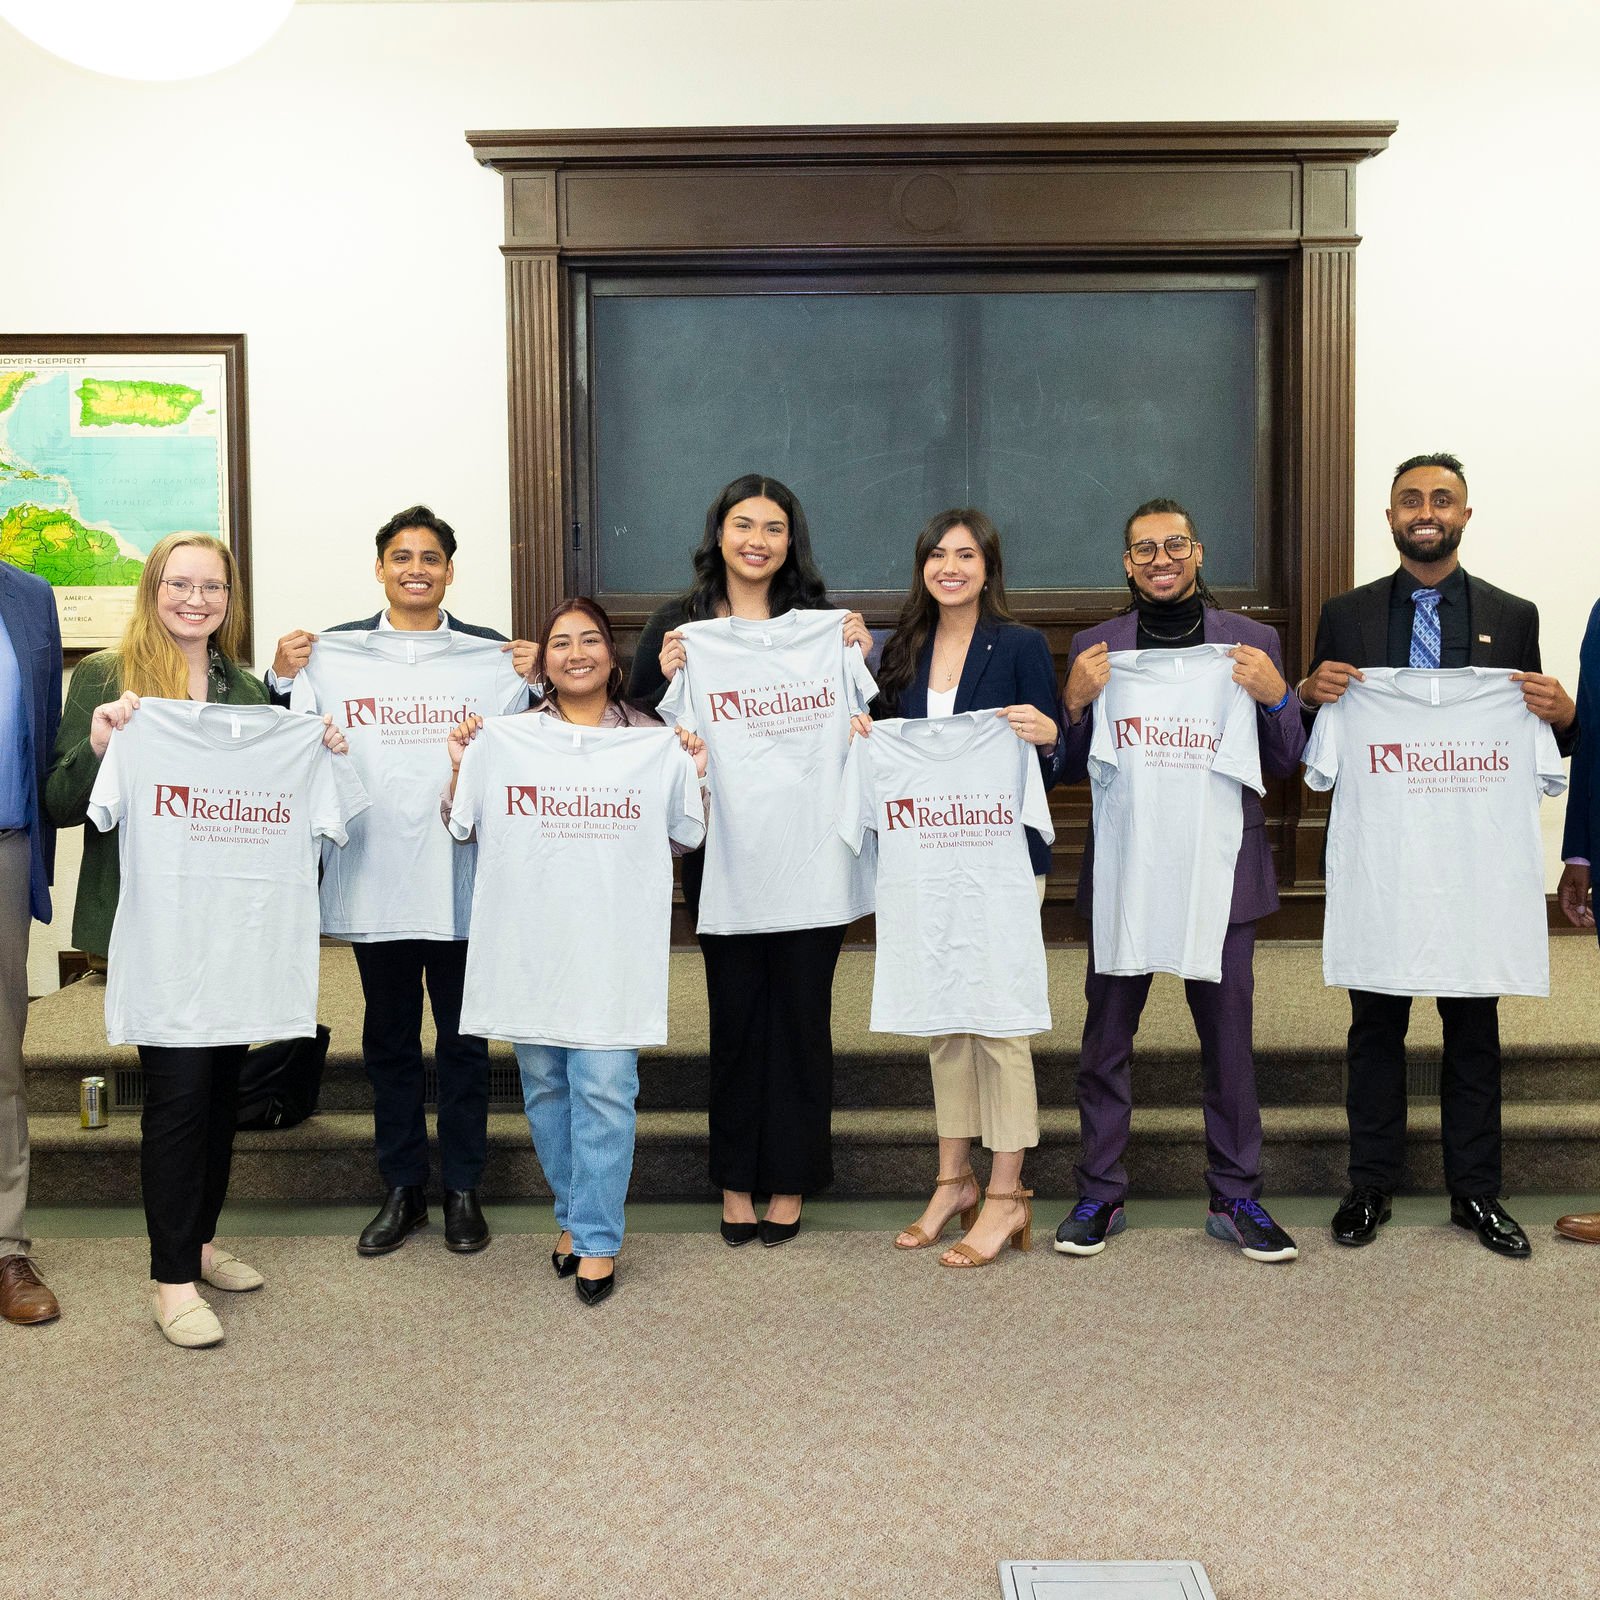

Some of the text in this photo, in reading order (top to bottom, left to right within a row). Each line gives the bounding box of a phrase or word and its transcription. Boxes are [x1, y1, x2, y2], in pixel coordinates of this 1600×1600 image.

[741, 680, 815, 695] UNIVERSITY
[743, 687, 836, 718] Redlands
[1144, 716, 1217, 727] UNIVERSITY
[1406, 750, 1509, 772] Redlands
[193, 787, 272, 797] UNIVERSITY
[916, 793, 990, 803] UNIVERSITY
[190, 797, 291, 824] Redlands
[540, 795, 641, 820] Redlands
[917, 803, 1014, 828] Redlands
